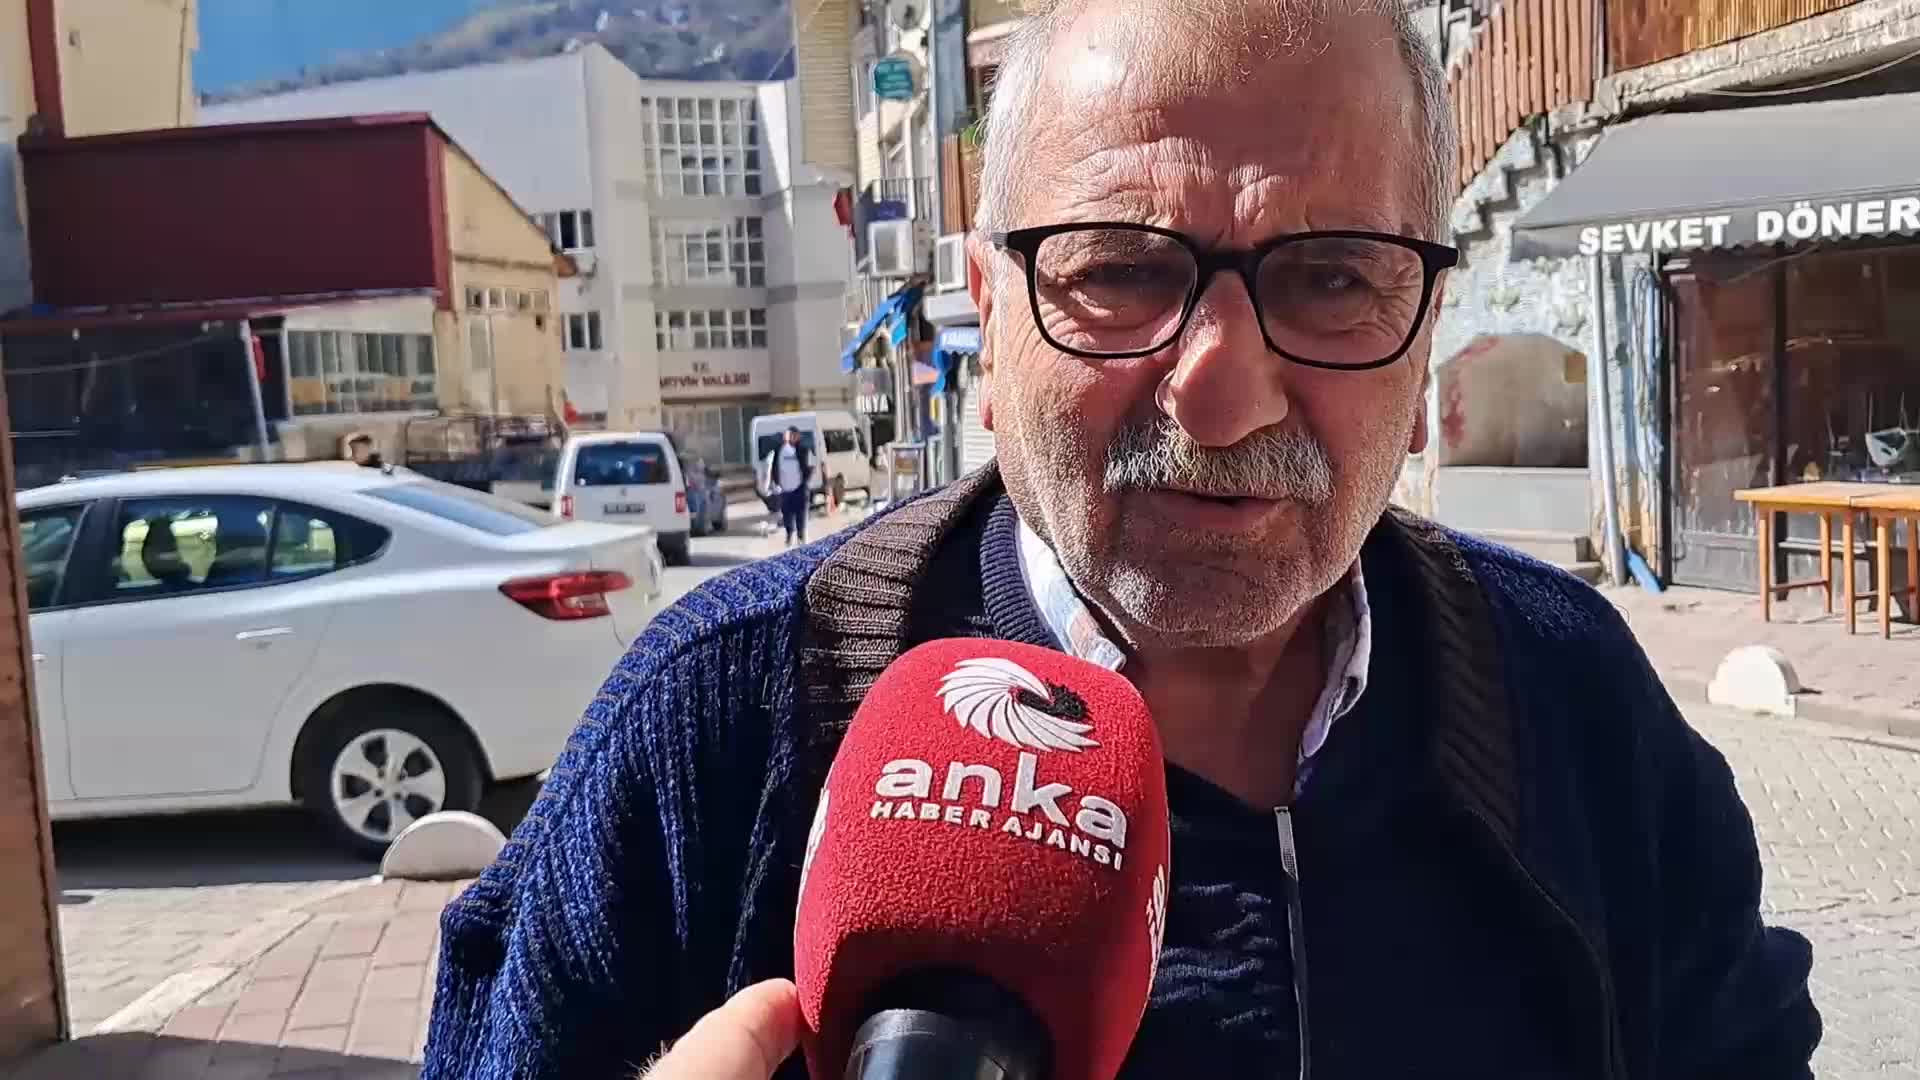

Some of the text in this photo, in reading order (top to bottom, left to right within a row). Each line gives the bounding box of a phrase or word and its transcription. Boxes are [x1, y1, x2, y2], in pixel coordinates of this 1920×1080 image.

[1578, 197, 1920, 255] SEVKET DÖNER
[870, 800, 1123, 872] HABER AJANSI
[875, 751, 1128, 849] anka
